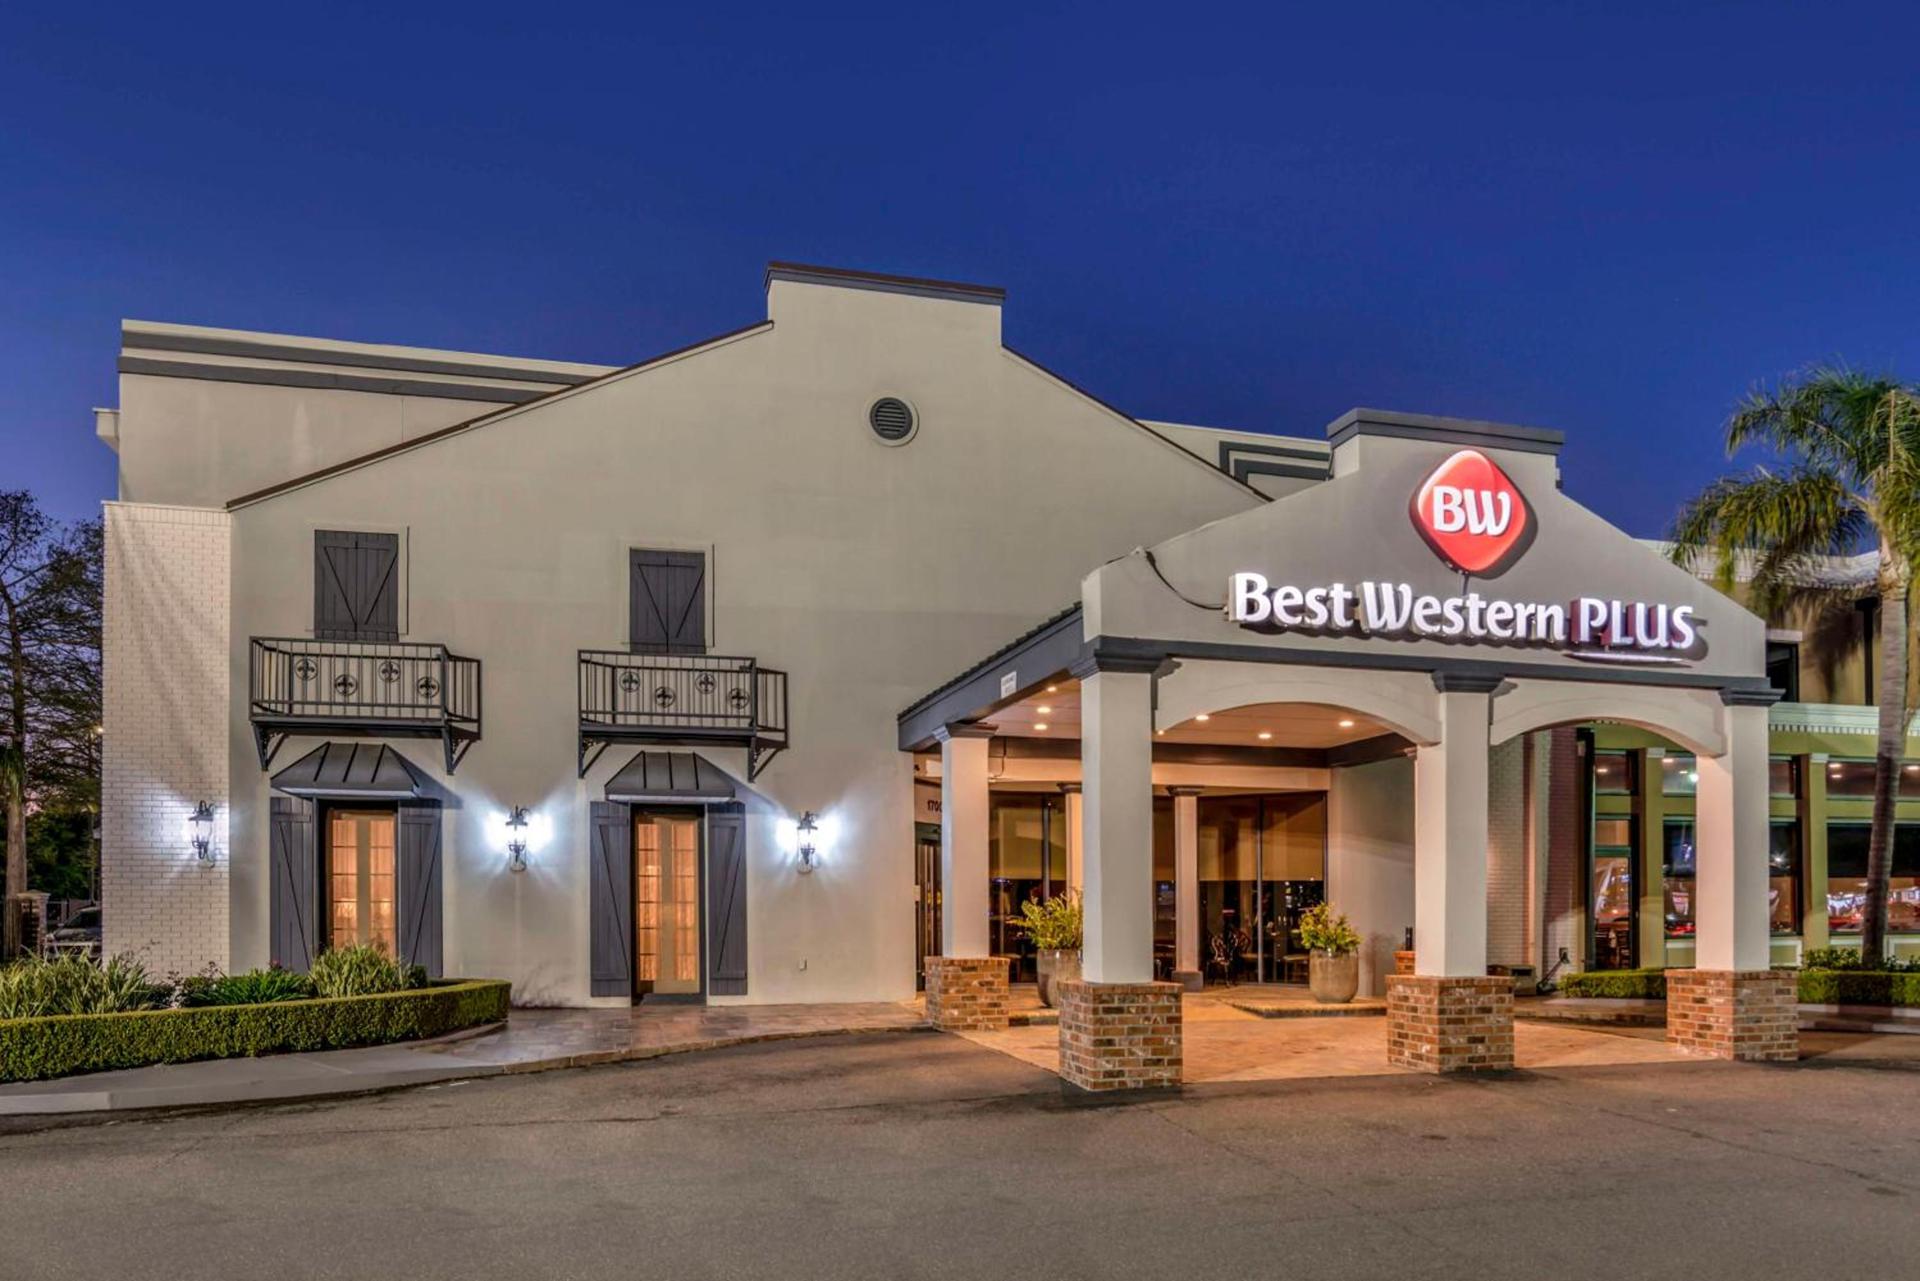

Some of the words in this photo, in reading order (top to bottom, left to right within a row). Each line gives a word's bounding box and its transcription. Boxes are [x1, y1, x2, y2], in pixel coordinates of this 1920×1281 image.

[1433, 485, 1511, 536] BW
[1233, 572, 1354, 628] Best
[1361, 581, 1566, 641] Western
[1577, 597, 1696, 649] PLUS
